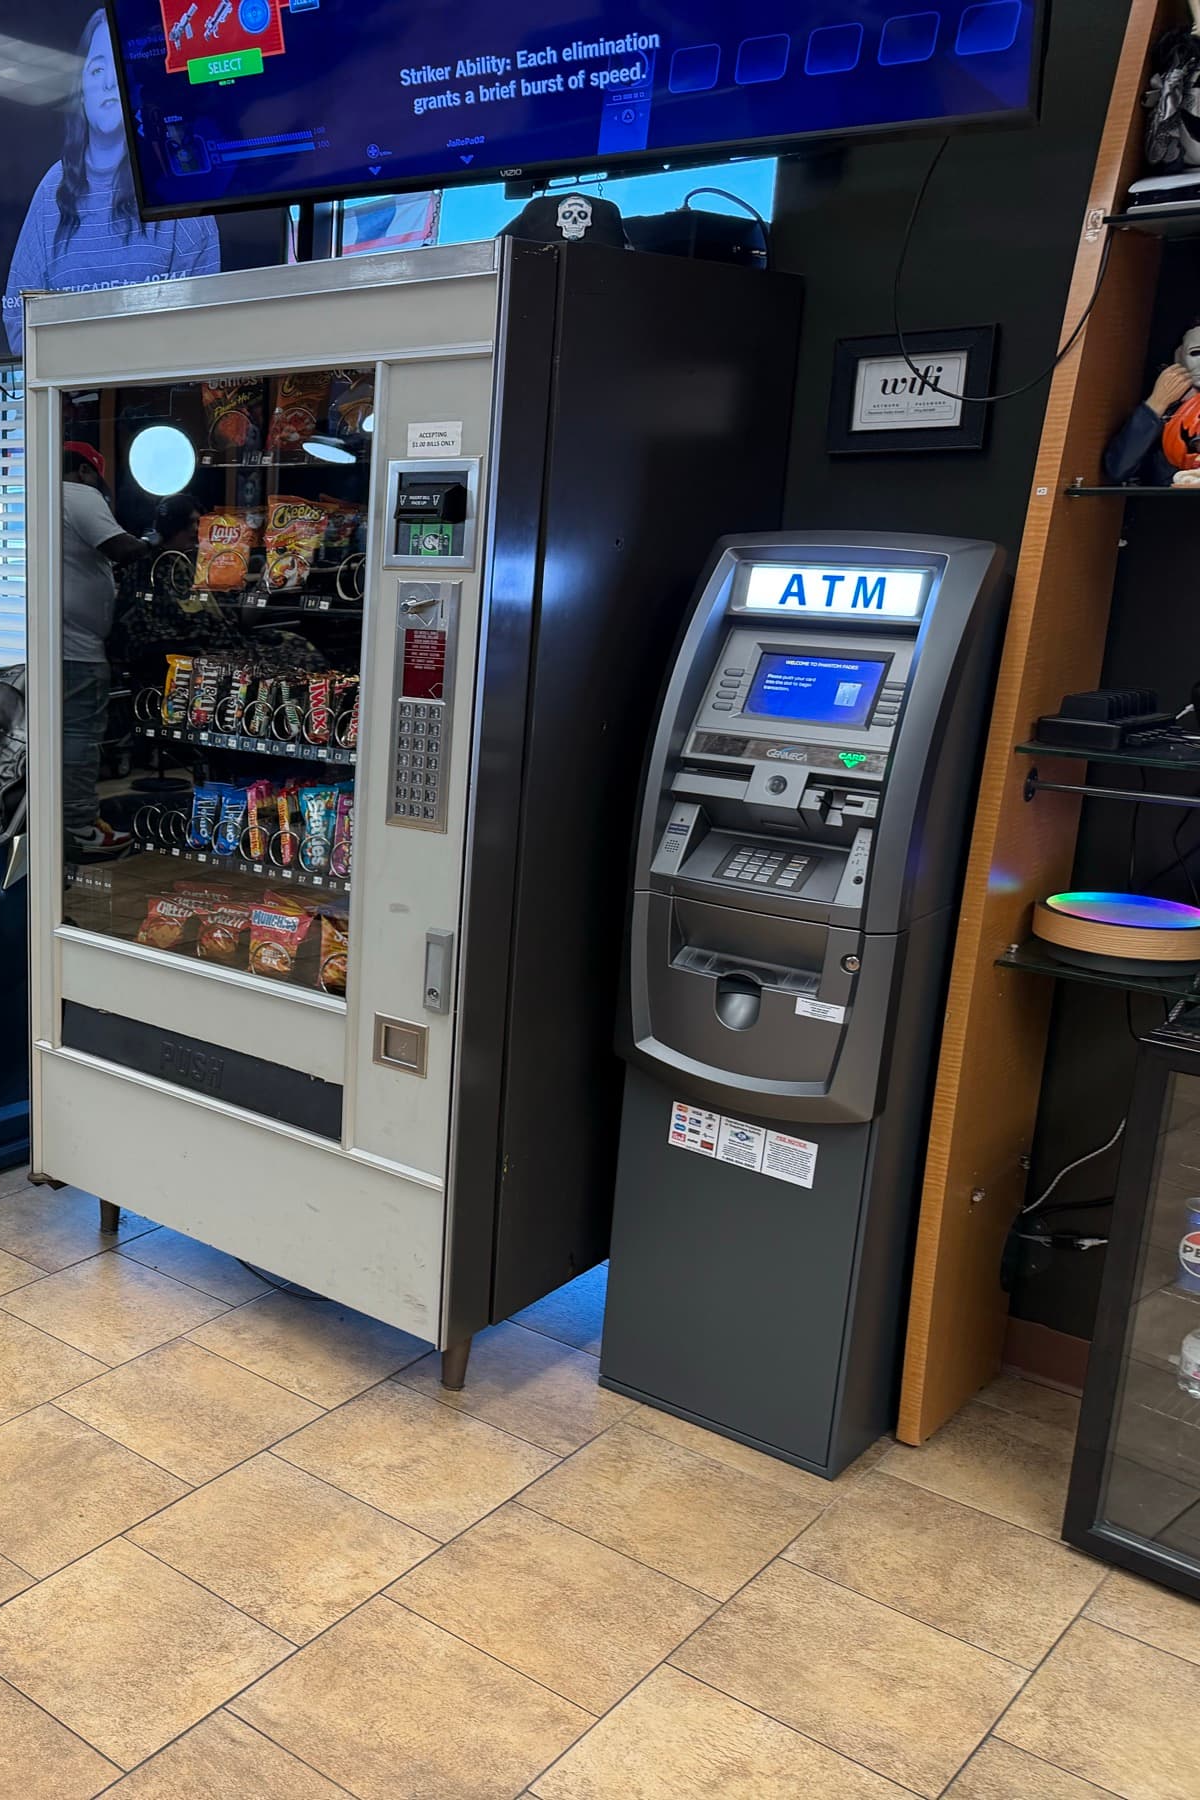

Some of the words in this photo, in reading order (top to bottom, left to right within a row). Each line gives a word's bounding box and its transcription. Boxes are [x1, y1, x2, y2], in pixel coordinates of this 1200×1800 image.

[208, 58, 242, 75] SELECT
[399, 64, 451, 86] Striker
[455, 57, 512, 78] Ability:
[516, 47, 558, 69] Each
[562, 33, 660, 61] elimination
[413, 90, 461, 115] grants
[465, 91, 475, 104] a
[479, 81, 517, 102] brief
[521, 75, 564, 96] burst
[568, 71, 587, 90] of
[590, 63, 647, 89] speed.
[499, 169, 522, 177] VIZIO
[880, 364, 943, 396] wifi
[272, 504, 325, 529] Cheetos
[778, 573, 887, 610] ATM
[309, 678, 328, 730] TWIX
[766, 748, 808, 761] GENMEGA
[838, 752, 867, 762] CARD
[159, 1040, 226, 1090] PUSH
